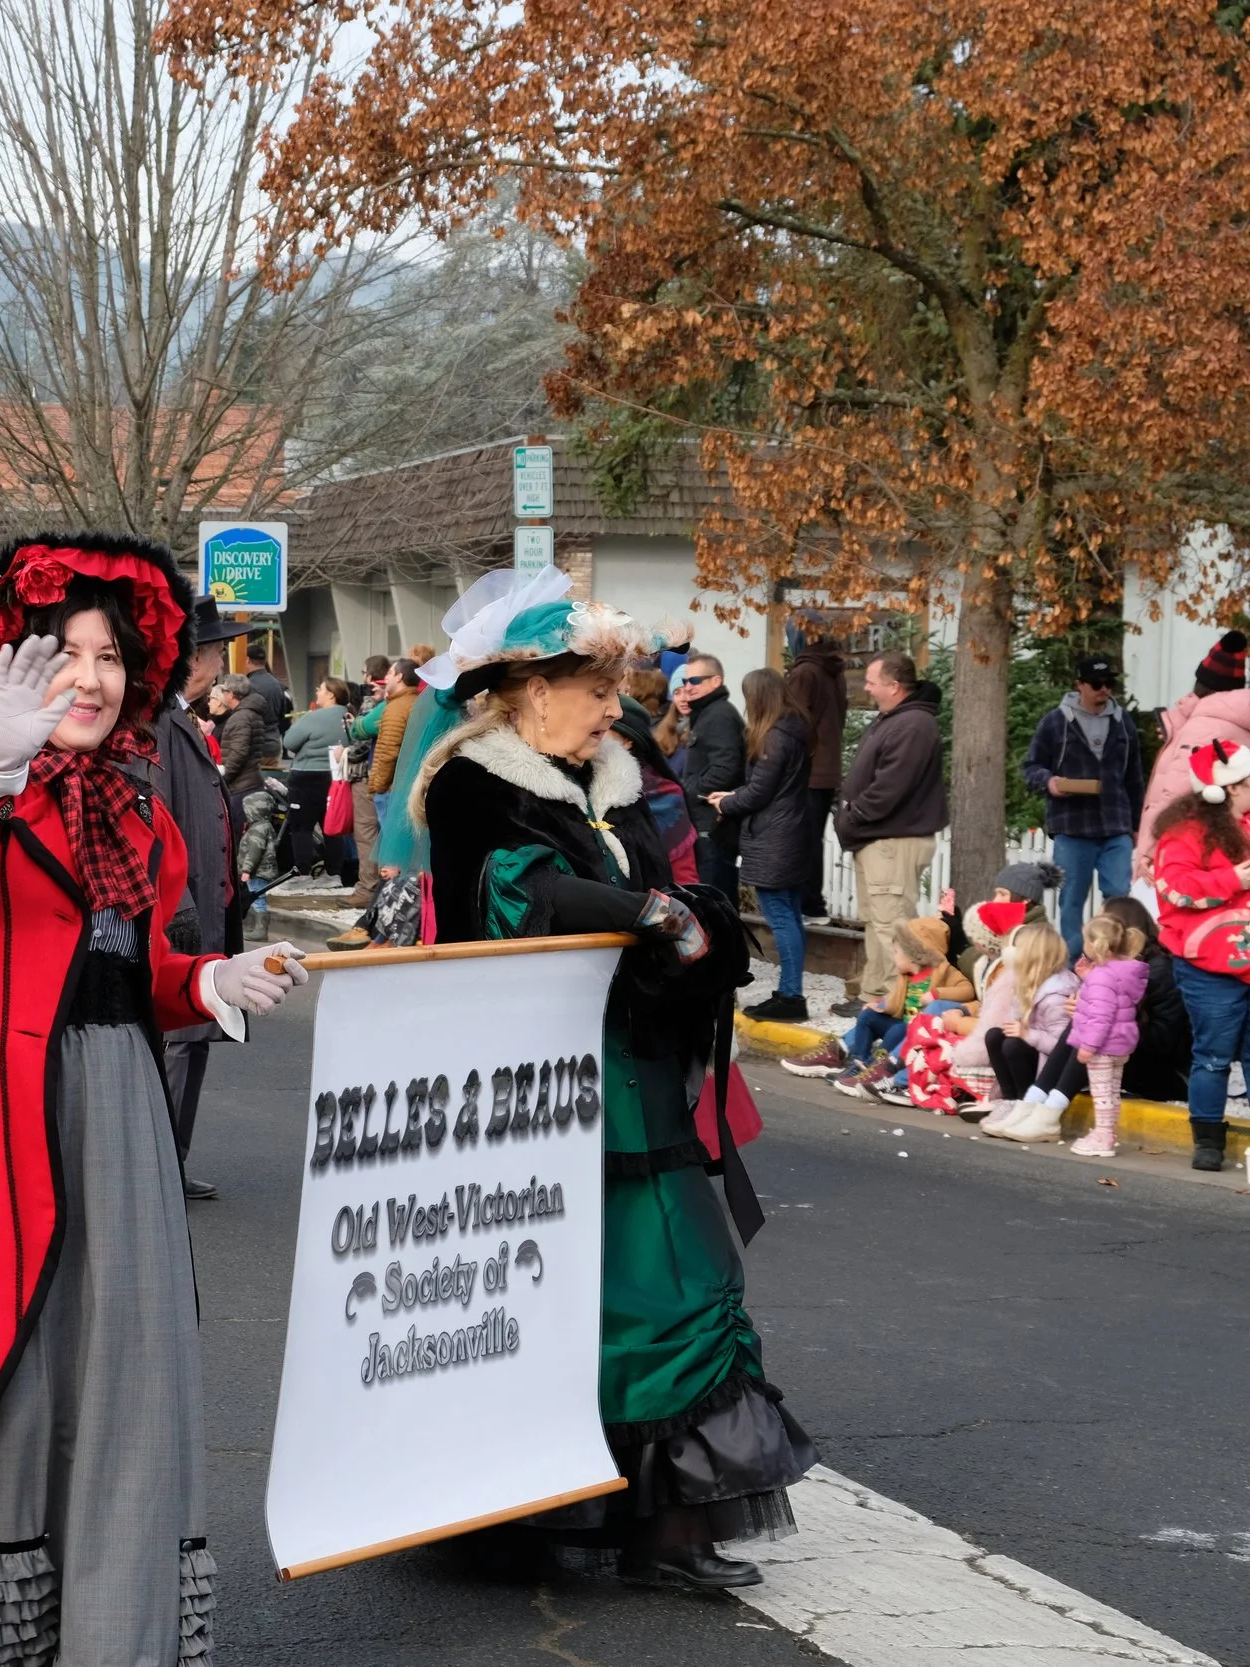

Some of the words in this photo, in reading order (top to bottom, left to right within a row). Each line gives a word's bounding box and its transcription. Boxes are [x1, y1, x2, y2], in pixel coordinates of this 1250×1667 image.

[516, 452, 526, 466] NO
[526, 453, 550, 463] PARKING
[520, 471, 546, 480] VEHICLES
[519, 482, 532, 491] OVER
[526, 494, 541, 502] HIGH
[527, 536, 541, 544] TWO
[213, 551, 273, 566] DISCOVERY
[524, 548, 543, 556] HOUR
[225, 566, 262, 580] DRIVE
[310, 1073, 449, 1170] BELLES
[452, 1068, 482, 1145] &
[484, 1053, 600, 1138] BEAUS
[331, 1200, 380, 1254] Old
[386, 1174, 565, 1246] West-Victorian
[382, 1253, 478, 1314] Society
[482, 1240, 509, 1292] of
[360, 1305, 520, 1385] Jacksonville
